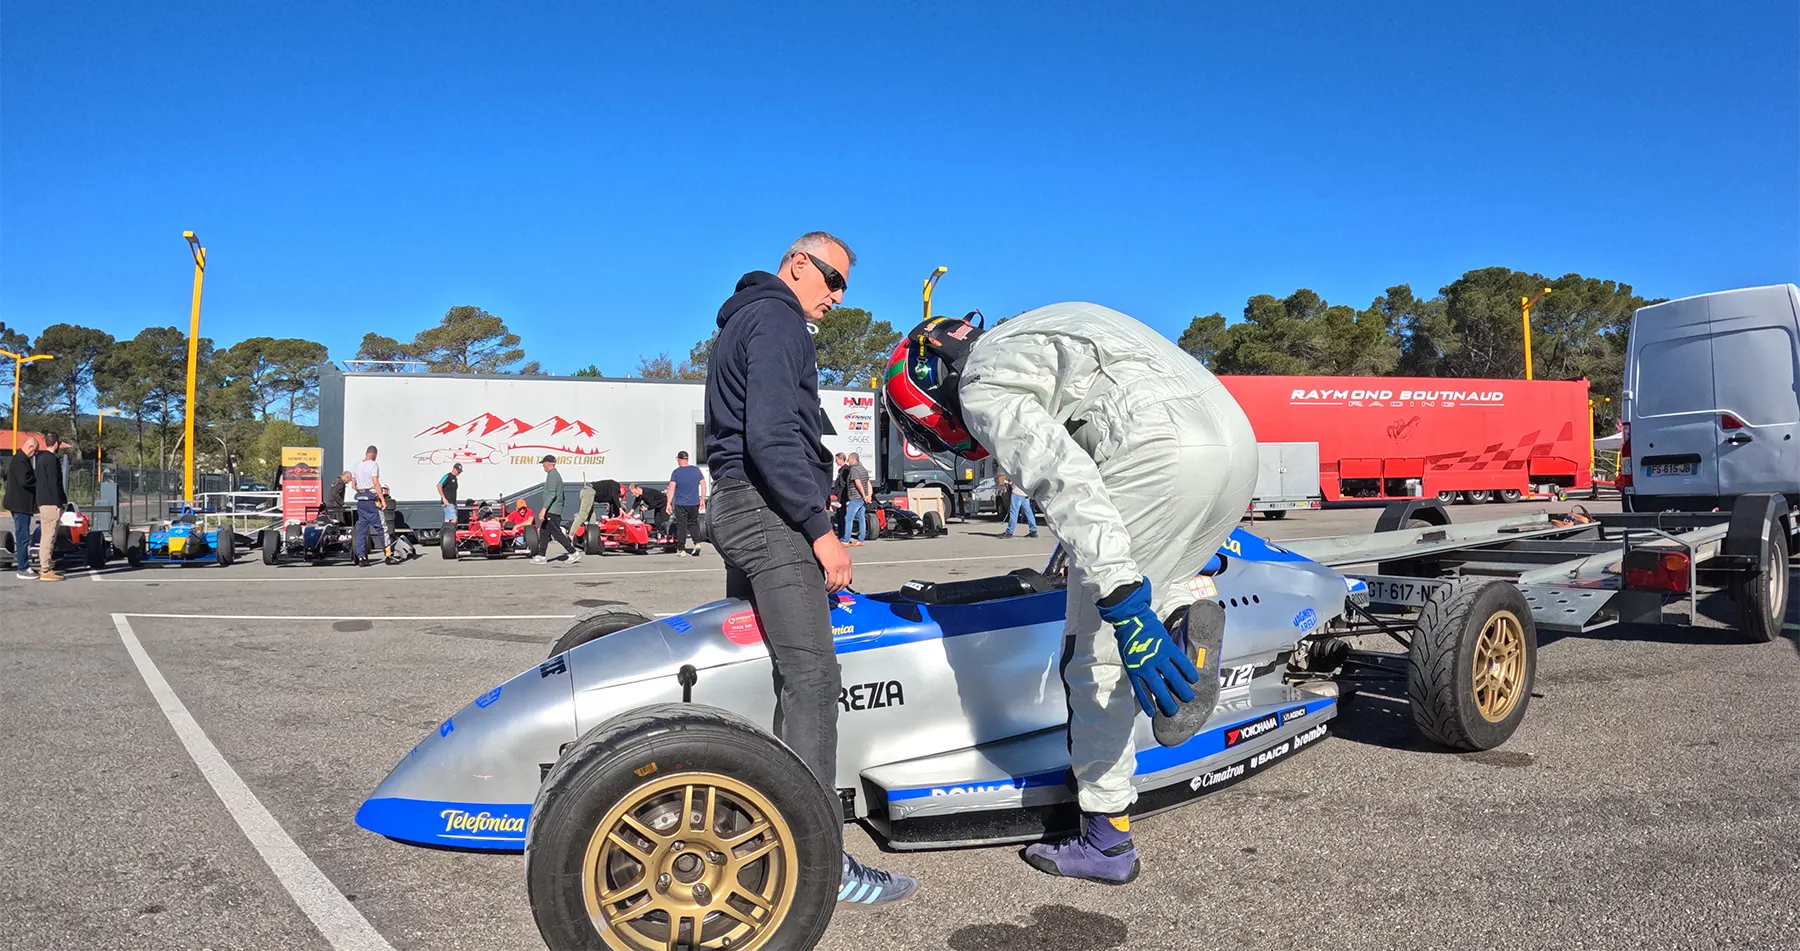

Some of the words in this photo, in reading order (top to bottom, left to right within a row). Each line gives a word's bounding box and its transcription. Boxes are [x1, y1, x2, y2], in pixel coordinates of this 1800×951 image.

[1290, 389, 1393, 400] RAYMOND
[1399, 390, 1504, 401] BOUTINAUD
[1348, 400, 1455, 408] RACING
[848, 435, 870, 444] SAGEC
[510, 455, 533, 465] TEAM
[536, 455, 573, 465] TMAS
[573, 455, 605, 465] CLAUSI
[1240, 717, 1278, 739] YOKOHAMA
[1202, 764, 1245, 788] Cimatron
[1294, 723, 1328, 750] brembo
